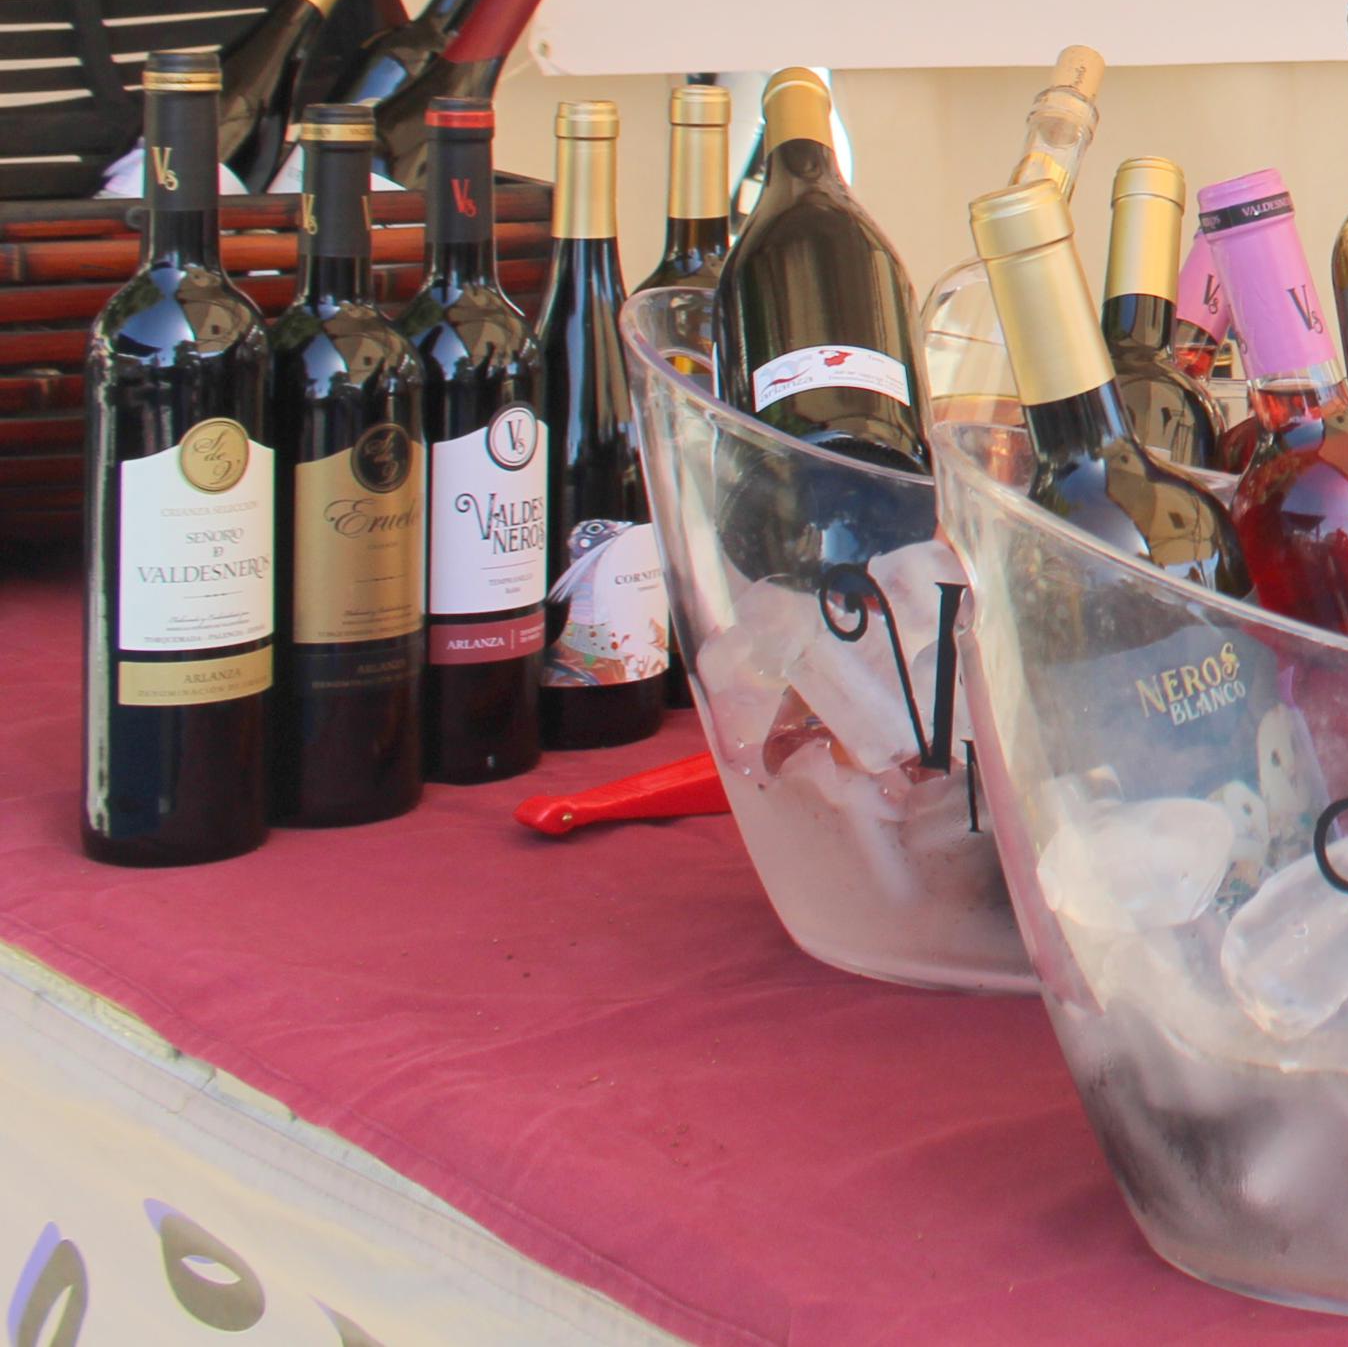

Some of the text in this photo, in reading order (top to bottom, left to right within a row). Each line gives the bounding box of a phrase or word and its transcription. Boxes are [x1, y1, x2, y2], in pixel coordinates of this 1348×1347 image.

[137, 554, 271, 584] VALDESNEROS
[446, 636, 506, 651] ARLANZA
[1135, 642, 1240, 719] NEROS
[1169, 680, 1247, 727] BLANCO
